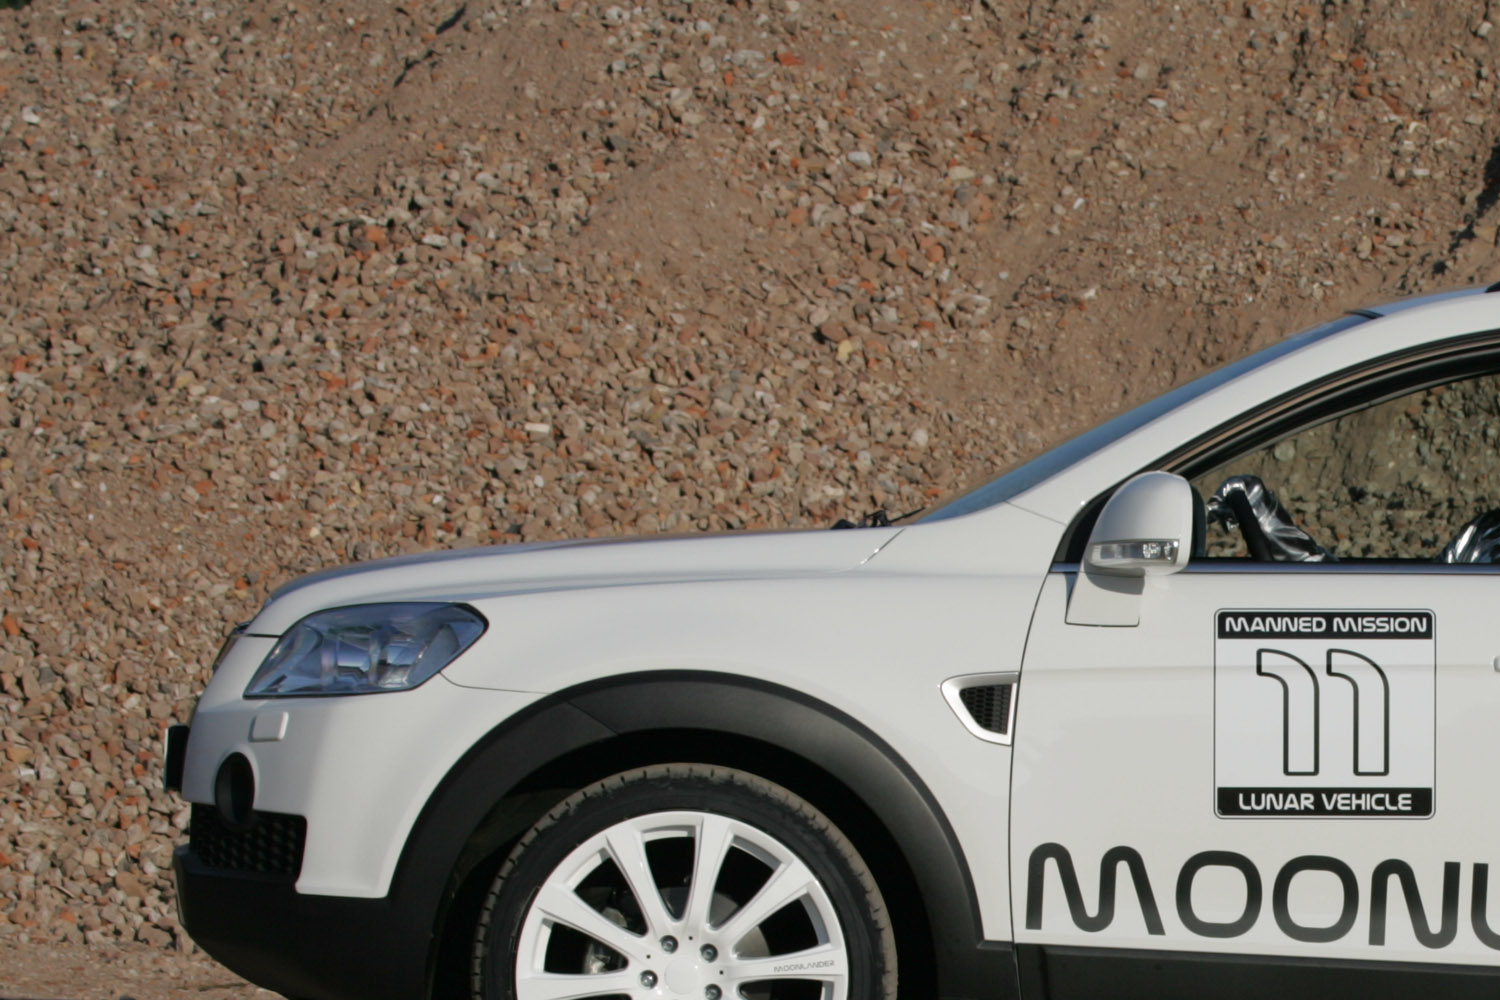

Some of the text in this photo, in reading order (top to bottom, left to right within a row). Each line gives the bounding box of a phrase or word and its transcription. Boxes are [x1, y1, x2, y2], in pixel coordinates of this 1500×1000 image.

[1224, 616, 1428, 633] MANNED MISSION
[1256, 648, 1390, 777] 11
[1238, 793, 1412, 811] LUNAR VEHICLE
[773, 960, 835, 973] MOONLANDER
